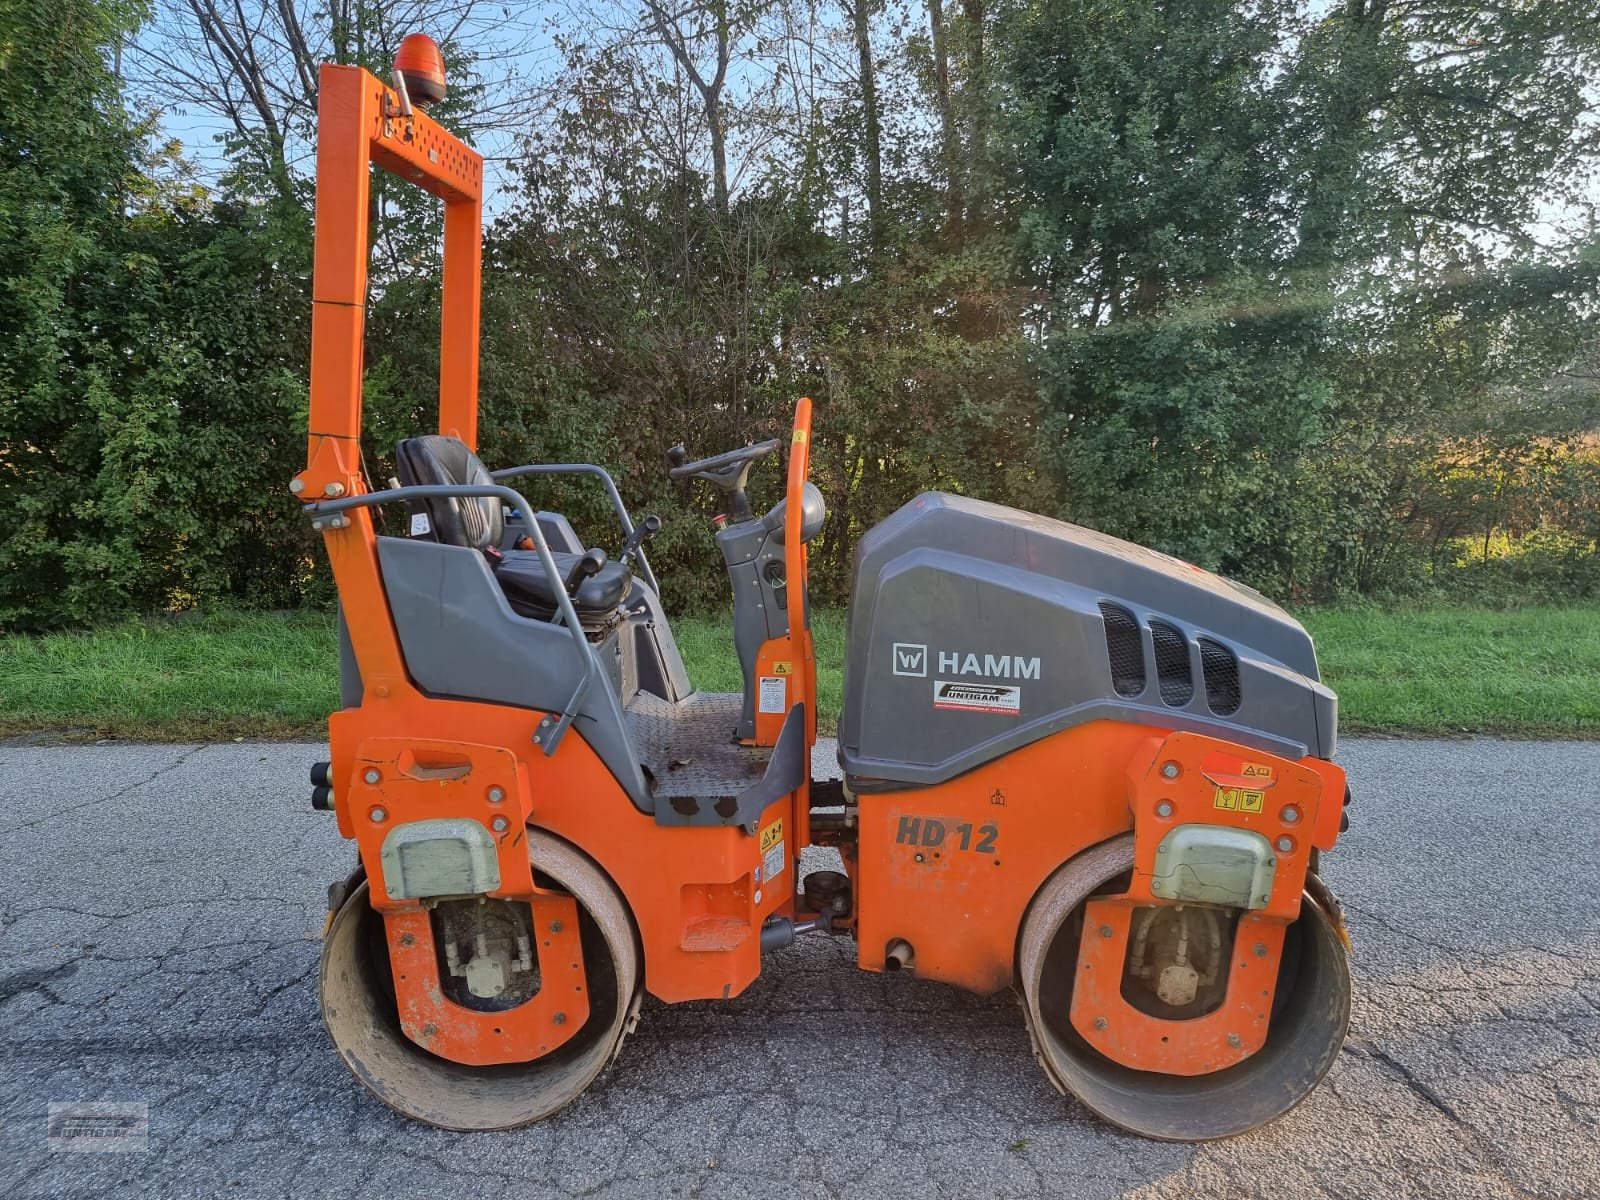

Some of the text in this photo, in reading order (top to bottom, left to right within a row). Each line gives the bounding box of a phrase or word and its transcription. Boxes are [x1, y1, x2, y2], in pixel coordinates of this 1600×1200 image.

[938, 651, 1041, 680] HAMM
[896, 816, 998, 853] HD 12
